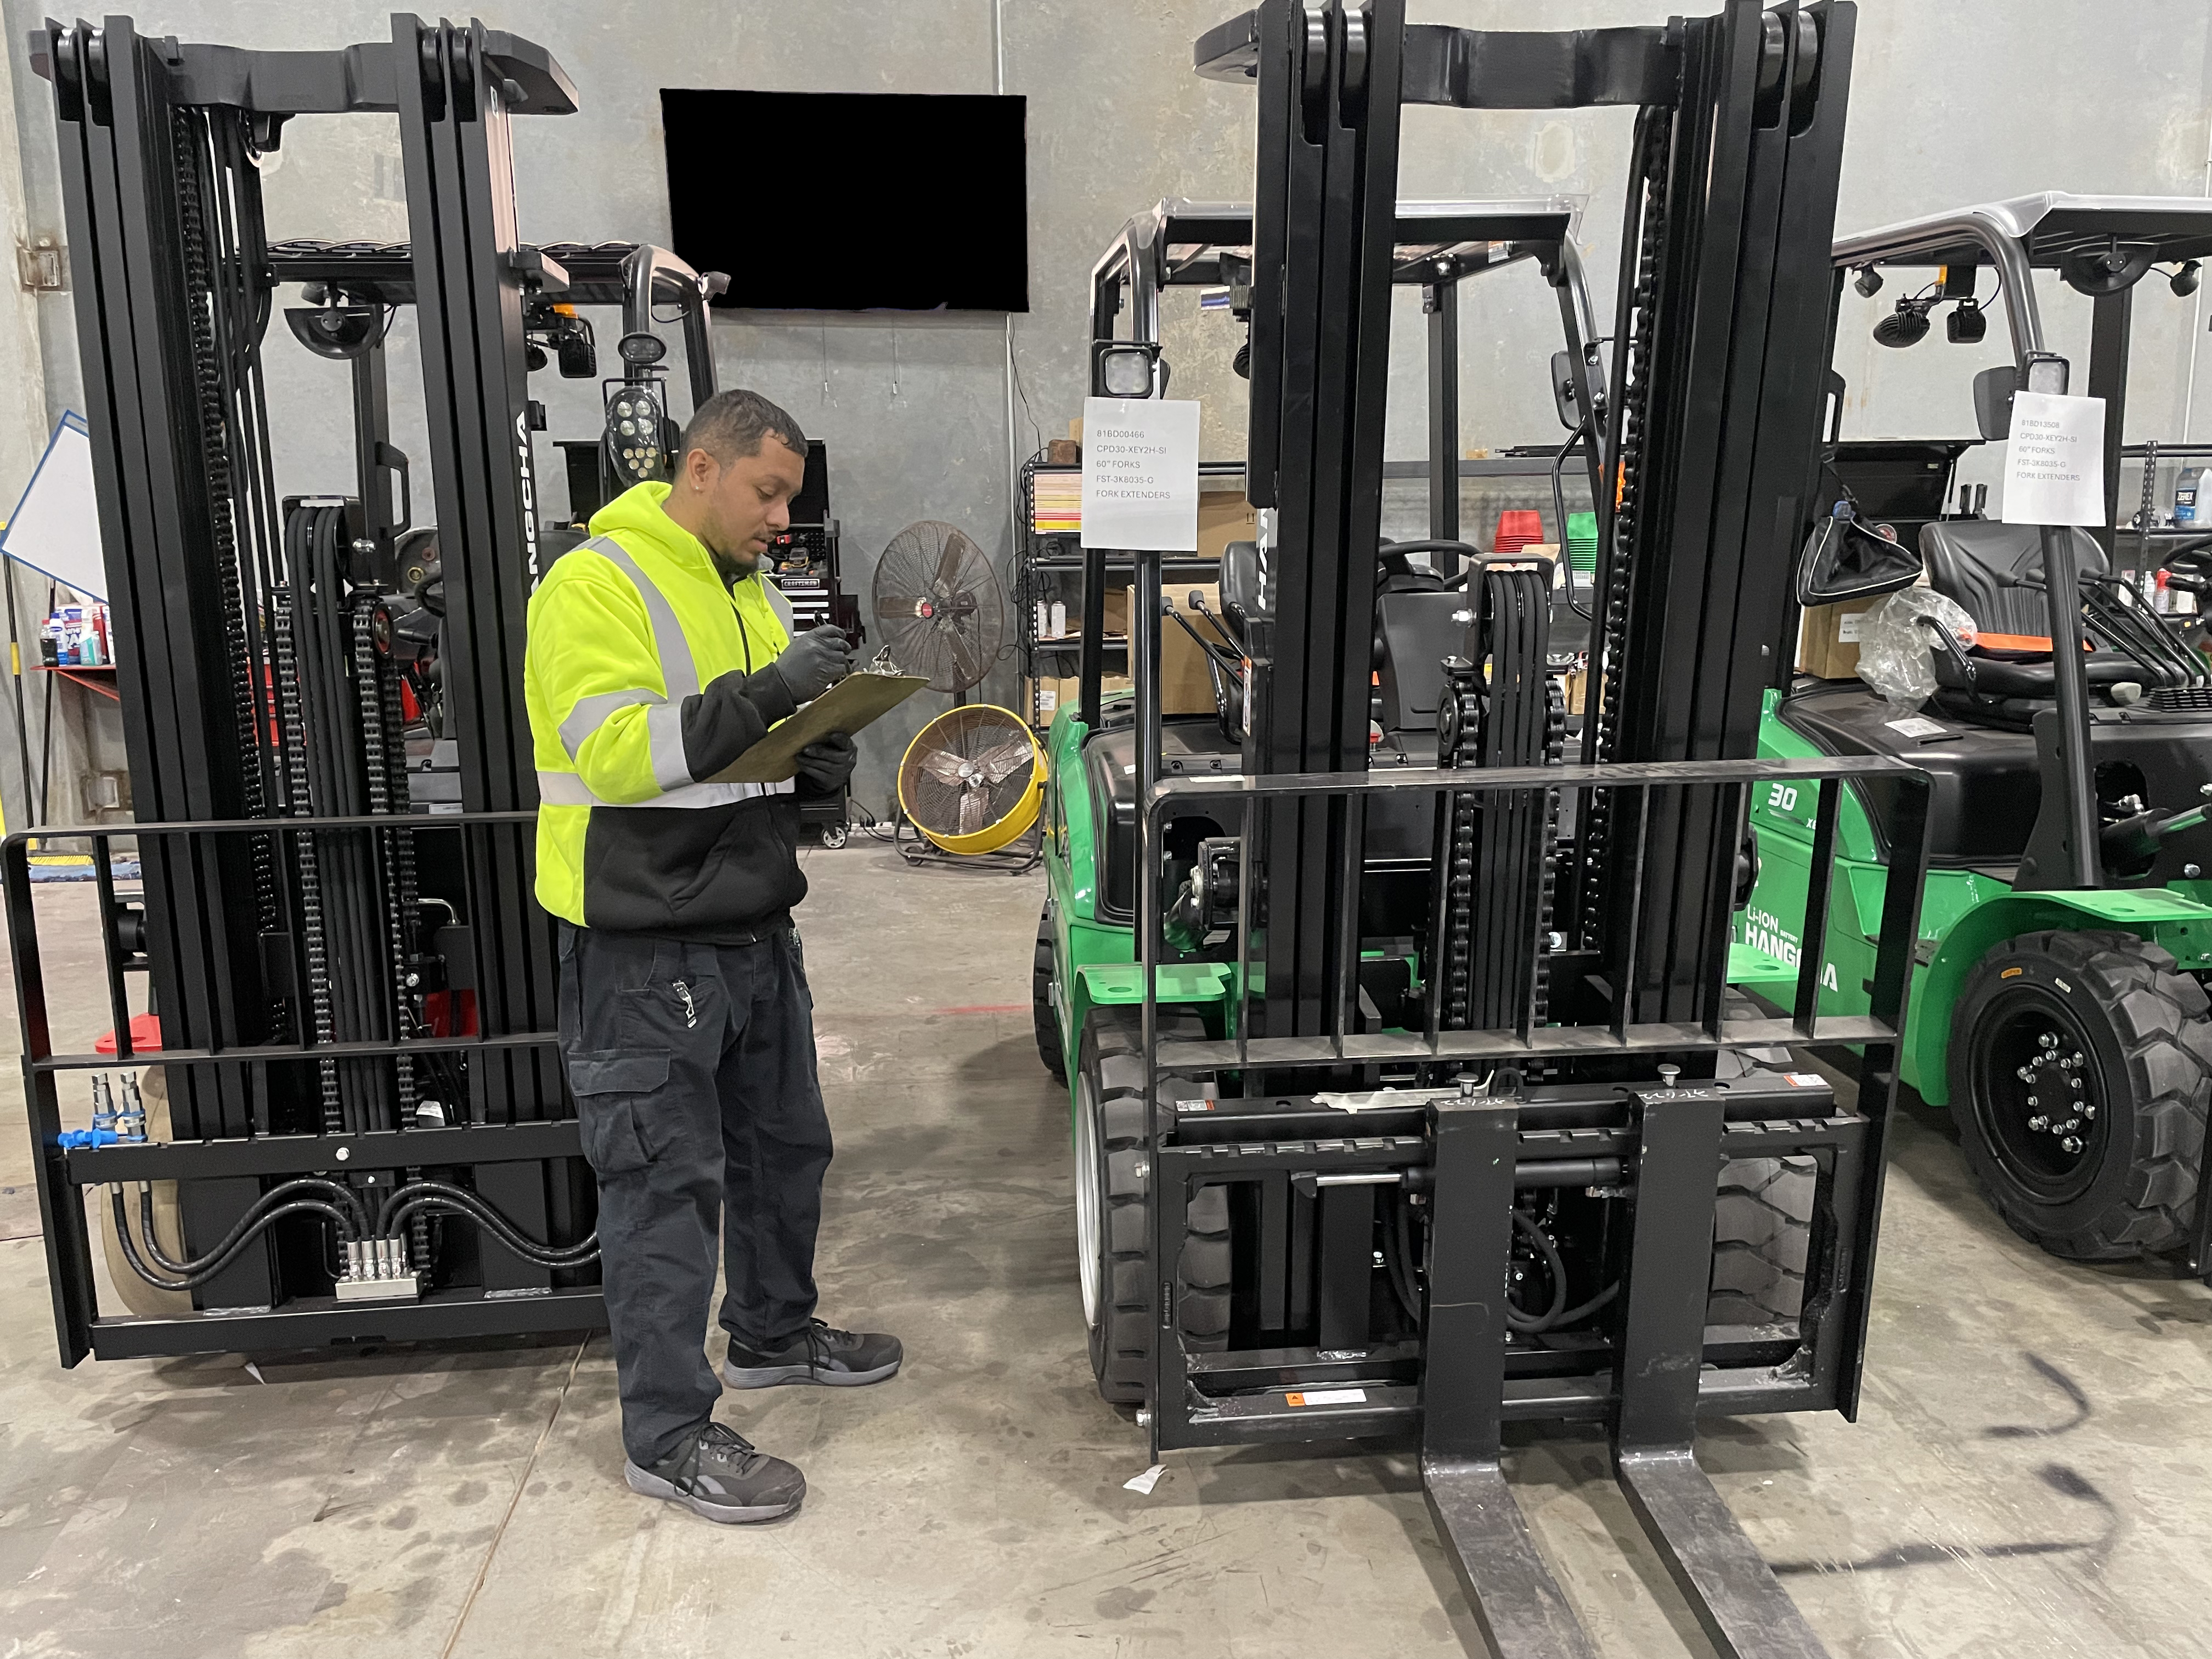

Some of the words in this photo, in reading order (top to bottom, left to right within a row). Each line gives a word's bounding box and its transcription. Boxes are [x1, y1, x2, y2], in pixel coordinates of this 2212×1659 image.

[2022, 420, 2060, 428] 81BD13508
[1097, 430, 1144, 438] 81BD00466
[1097, 445, 1166, 454] CPD30-XEY2H-SI
[1096, 476, 1154, 484] FST-3K8035-G
[2038, 473, 2080, 481] EXTENDERS
[1121, 490, 1170, 499] EXTENDERS
[1768, 783, 1797, 811] 30
[1747, 904, 1779, 933] Li-ION
